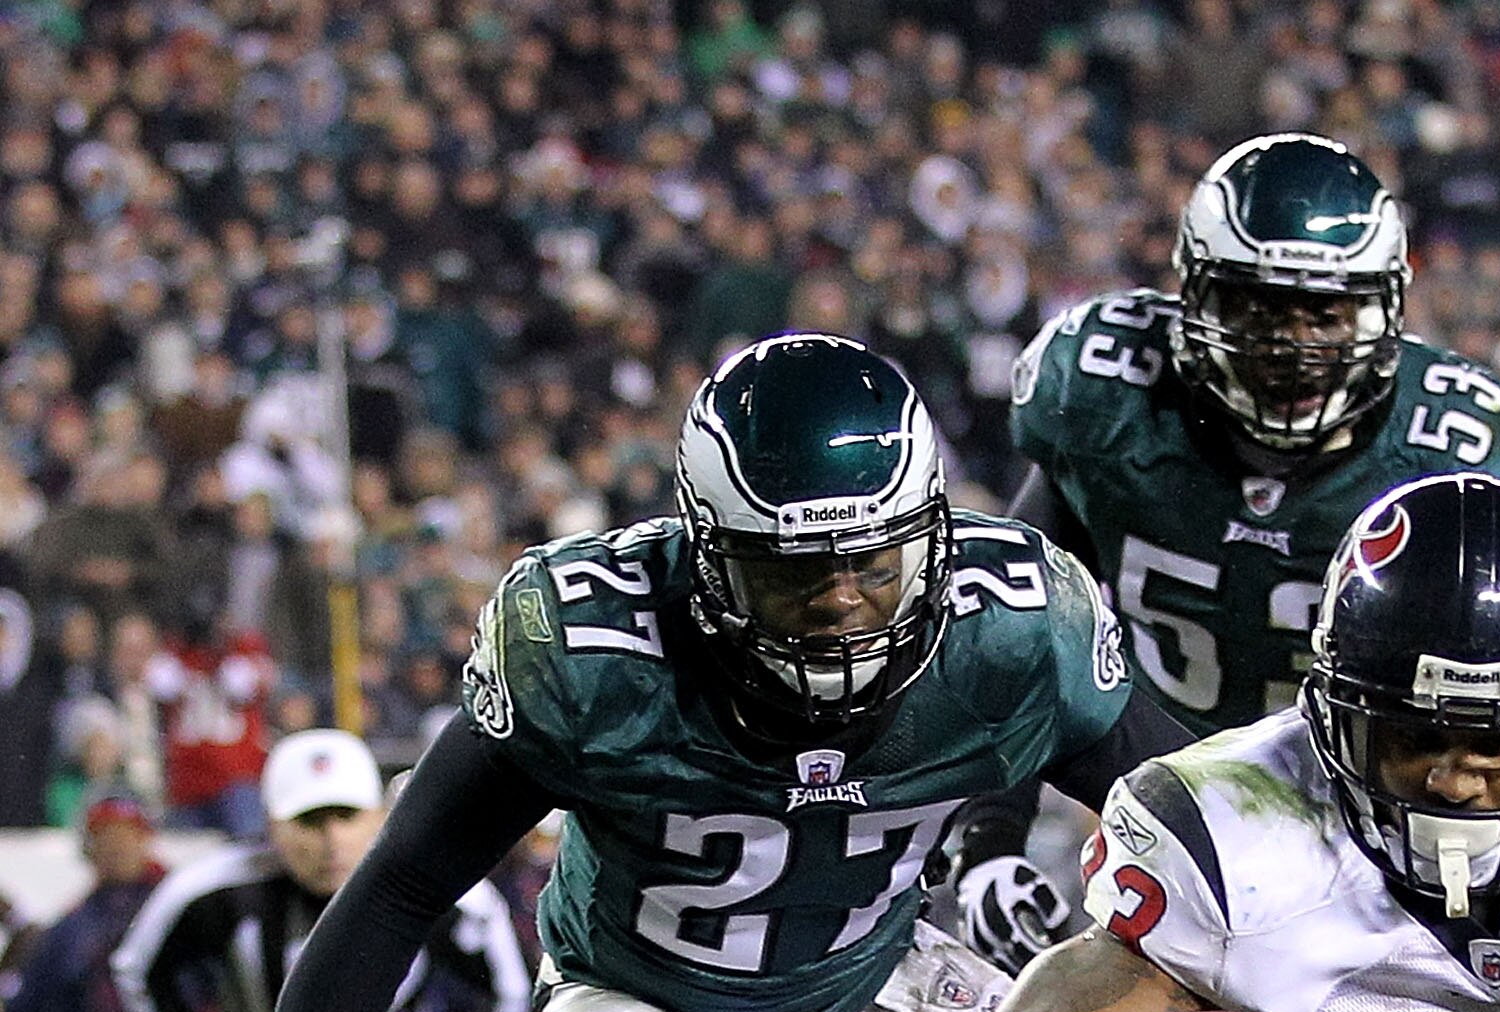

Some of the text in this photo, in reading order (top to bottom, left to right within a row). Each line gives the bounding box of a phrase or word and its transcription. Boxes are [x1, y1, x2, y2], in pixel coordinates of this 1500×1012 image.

[1079, 298, 1182, 387] 53
[802, 503, 857, 522] Riddell
[548, 560, 665, 658] 27
[1443, 668, 1500, 684] Riddell
[785, 781, 868, 813] EAGLES
[636, 798, 969, 971] 27
